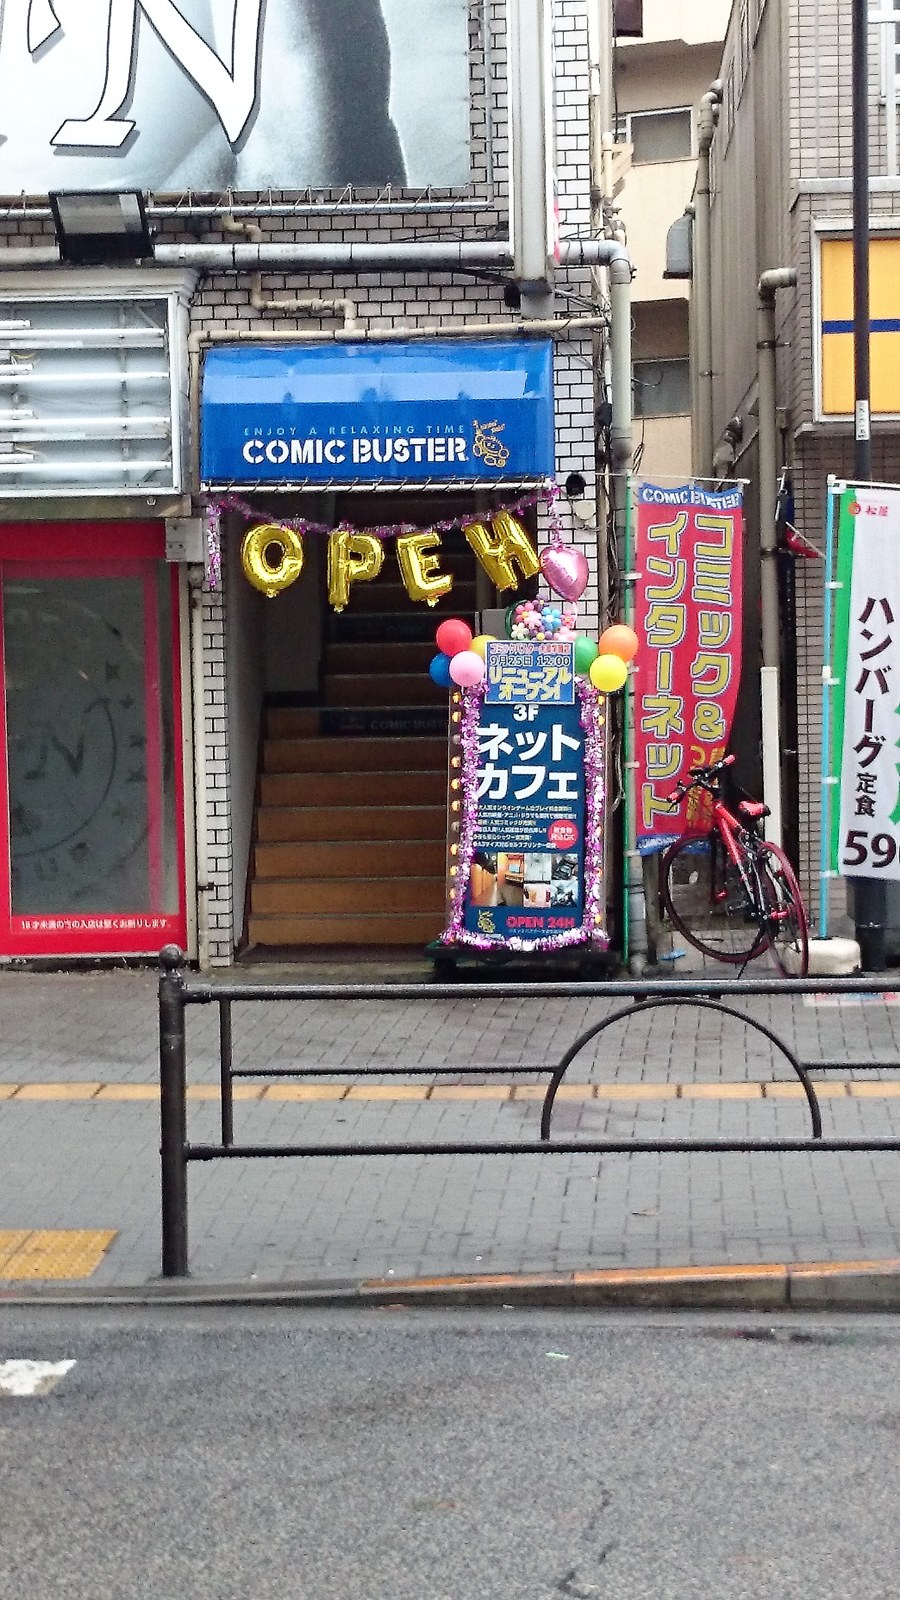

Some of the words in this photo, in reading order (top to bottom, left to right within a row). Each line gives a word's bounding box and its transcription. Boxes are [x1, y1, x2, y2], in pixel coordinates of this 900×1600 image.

[244, 427, 297, 436] ENJOY
[309, 428, 318, 436] A
[329, 425, 416, 435] RELAXING
[426, 424, 465, 434] TIME
[242, 439, 346, 464] COMIC
[352, 437, 466, 463] BUSTER
[642, 488, 688, 504] COMIC
[691, 513, 734, 742] コミック&
[490, 654, 533, 666] 9月25日
[641, 510, 688, 829] インターネット
[489, 666, 573, 685] リニューアル
[513, 704, 539, 722] 3F
[475, 723, 581, 761] ネット
[475, 762, 579, 800] カフェ
[842, 832, 900, 869] 59
[506, 916, 545, 928] OPEN
[547, 916, 576, 928] 24H
